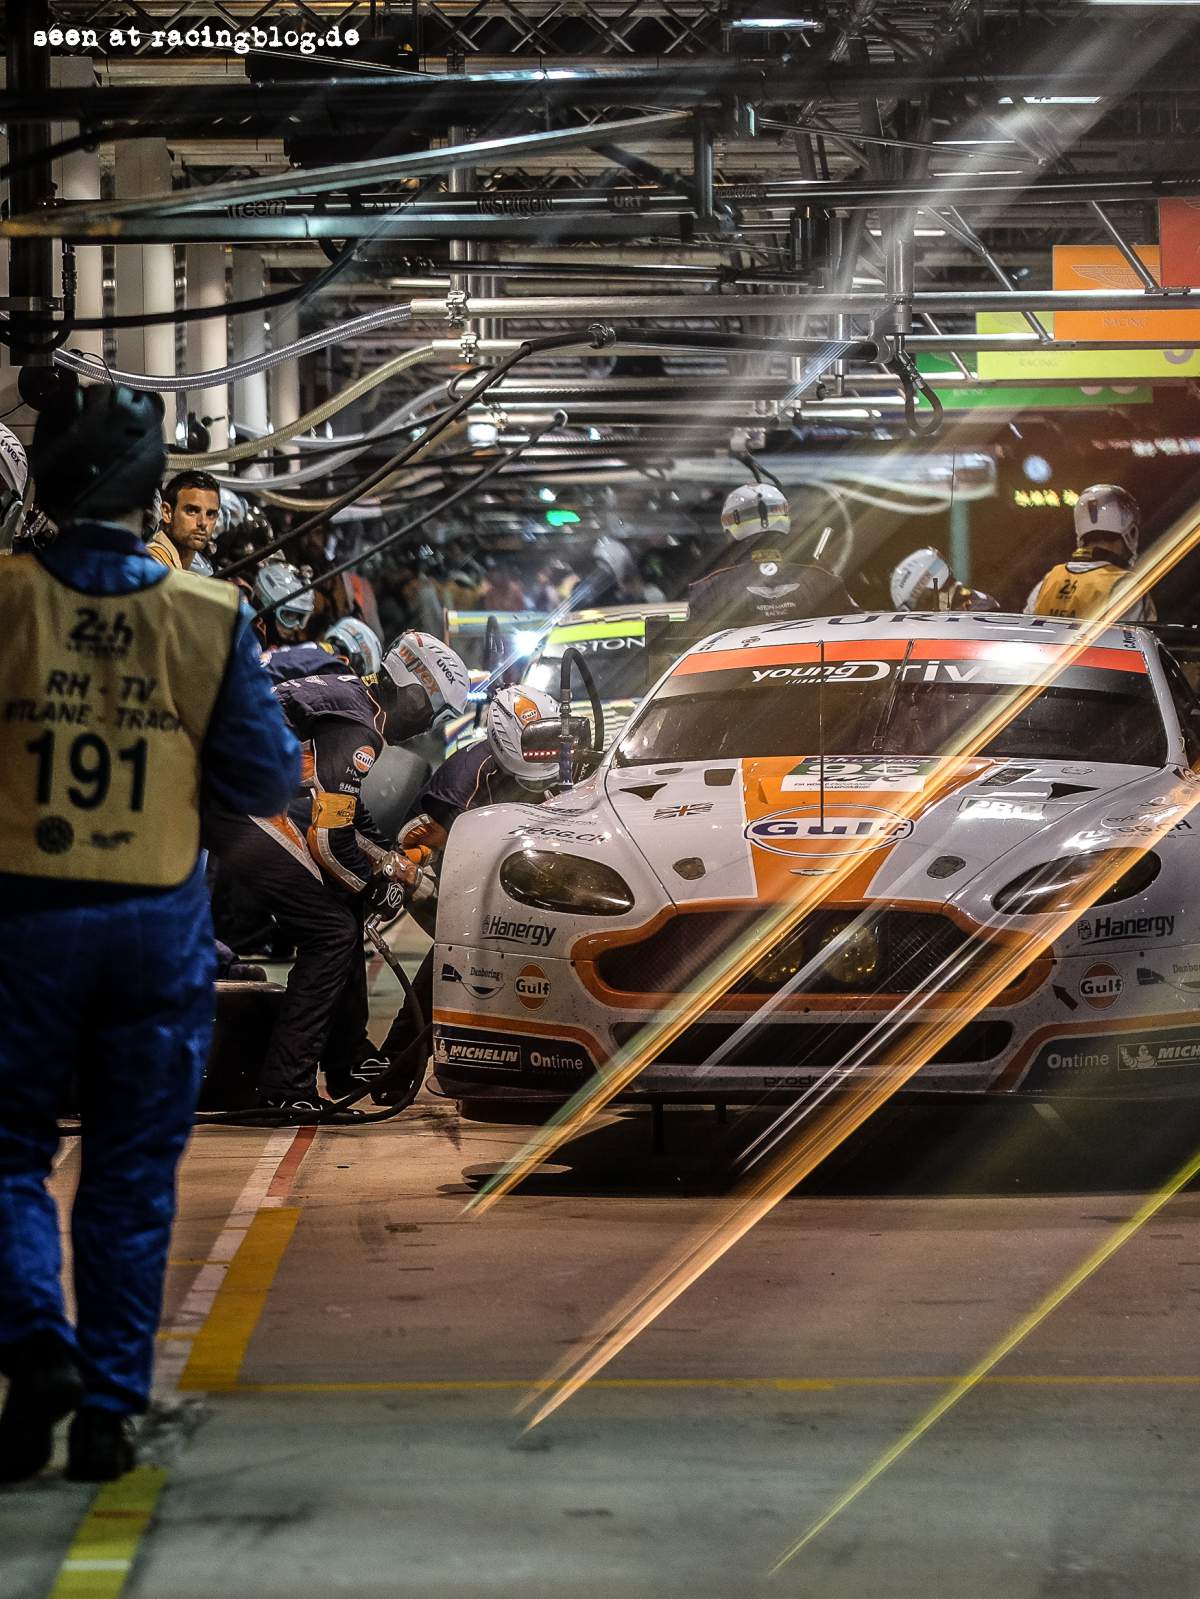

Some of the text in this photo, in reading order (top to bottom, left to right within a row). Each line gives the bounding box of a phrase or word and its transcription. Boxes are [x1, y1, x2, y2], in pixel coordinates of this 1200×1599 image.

[562, 637, 646, 656] STON
[436, 658, 456, 685] uvex
[25, 729, 148, 812] 191
[488, 916, 557, 946] Hanergy
[1094, 915, 1175, 938] Hanergy
[516, 978, 550, 995] Gulf
[1080, 979, 1122, 995] Gulf
[450, 1045, 519, 1062] MICHELIN
[530, 1052, 584, 1070] Ontime
[1047, 1053, 1110, 1069] Ontime
